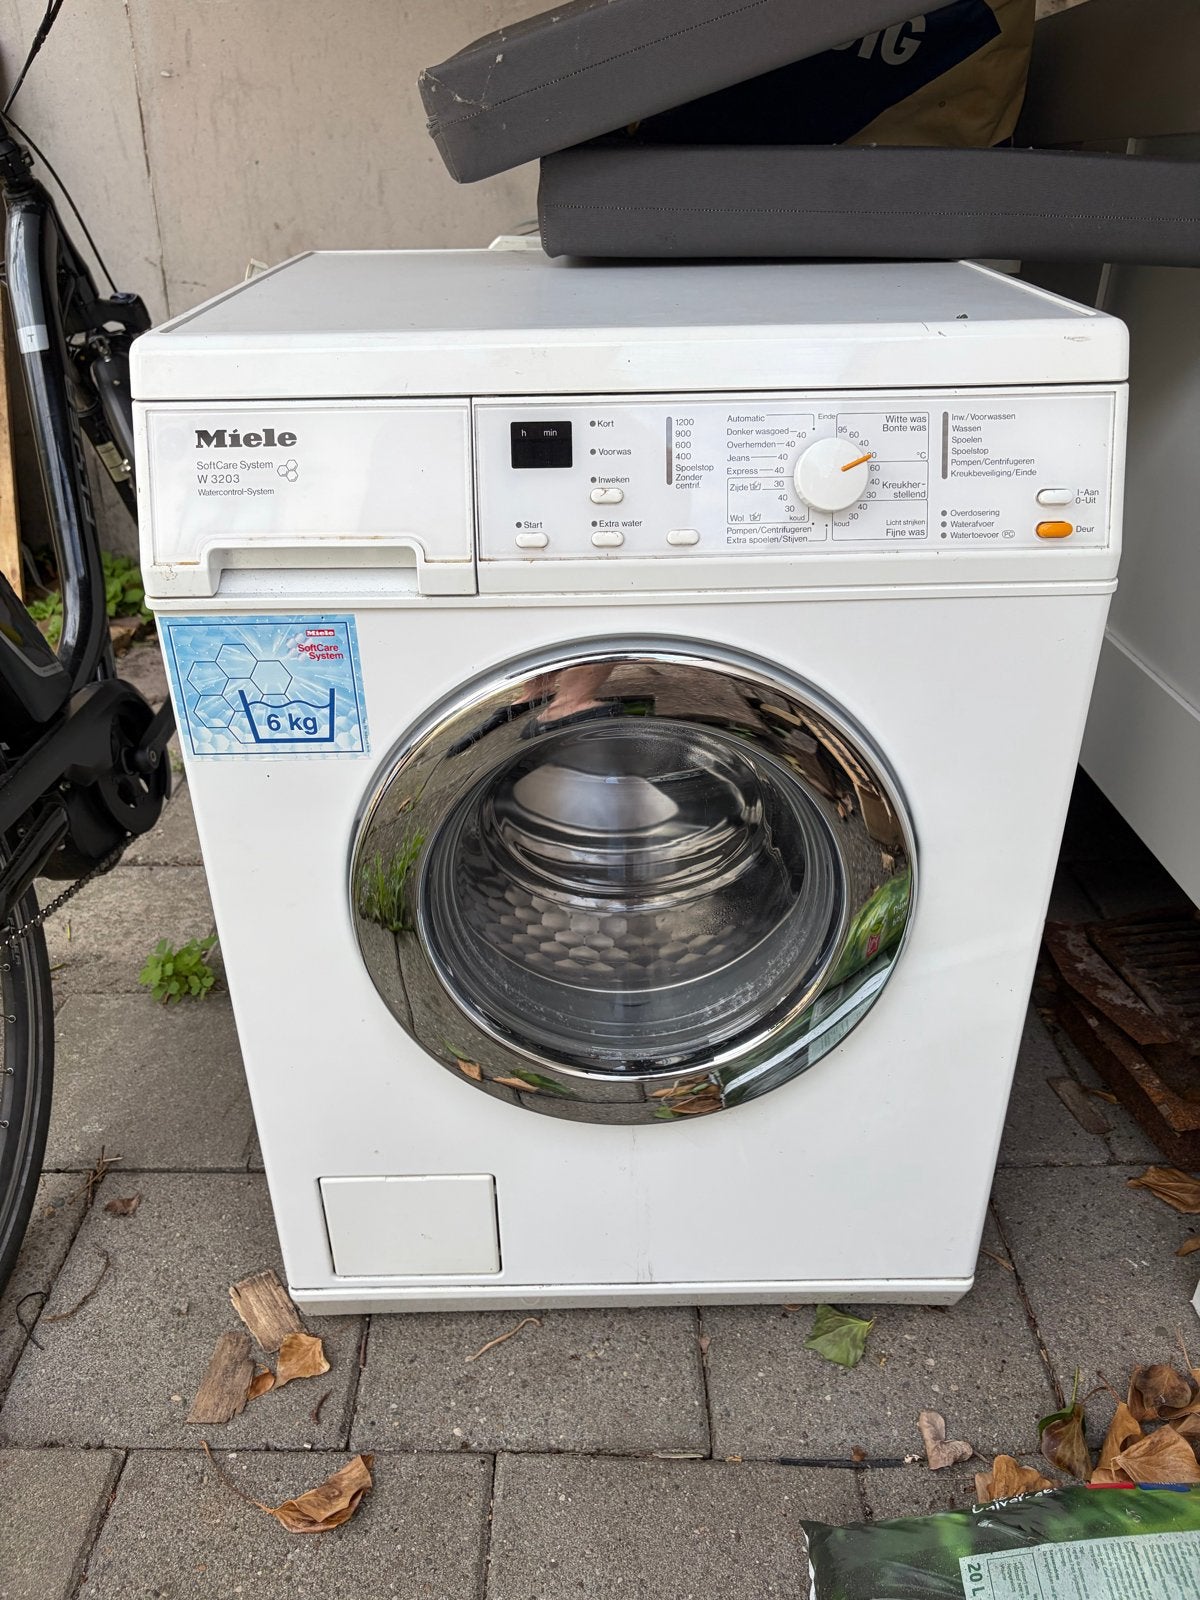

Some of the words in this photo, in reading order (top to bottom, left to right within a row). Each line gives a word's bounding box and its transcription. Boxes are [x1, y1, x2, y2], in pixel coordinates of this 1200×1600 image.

[675, 418, 694, 426] 1200
[885, 415, 908, 423] Witte
[598, 420, 614, 428] Kort
[882, 424, 908, 432] Bonte
[521, 429, 527, 437] h
[543, 429, 558, 437] min
[675, 430, 691, 438] 900
[726, 428, 753, 436] Donker
[755, 428, 790, 436] wasgoed
[838, 426, 848, 434] 95
[195, 428, 297, 448] Miele
[952, 436, 982, 444] Spoelen
[786, 440, 796, 448] 40
[598, 448, 632, 456] Voorwas
[952, 448, 989, 456] Spoelstop
[727, 454, 750, 462] Jeans
[196, 461, 238, 470] SoftCare
[240, 460, 274, 471] System
[951, 458, 1034, 467] Pompen/Centrifugeren
[675, 464, 714, 473] Spoelstop
[726, 468, 758, 476] Express
[870, 464, 880, 472] 60
[950, 469, 1037, 478] Kreukbeveiliging/Einde
[197, 474, 208, 484] W
[210, 474, 240, 484] 3203
[598, 476, 630, 484] Inweken
[675, 474, 703, 482] Zonder
[870, 478, 880, 486] 40
[730, 483, 748, 492] Zijde
[774, 480, 784, 488] 30
[198, 488, 274, 496] Watercontrol-System
[893, 490, 926, 498] stellend
[730, 514, 744, 522] Wol
[848, 512, 858, 520] 30
[950, 510, 1000, 518] Overdosering
[524, 521, 543, 529] Start
[599, 520, 619, 528] Extra
[622, 520, 643, 528] water
[726, 526, 812, 536] Pompen/Centrifugeren
[886, 528, 908, 538] Fijne
[726, 536, 746, 544] Extra
[749, 534, 808, 544] spoelen/Stijven
[950, 532, 999, 540] Watertoevoer
[297, 644, 339, 652] SoftCare
[309, 652, 344, 661] System
[266, 714, 281, 731] 6
[289, 713, 318, 735] kg
[967, 1562, 984, 1582] 20
